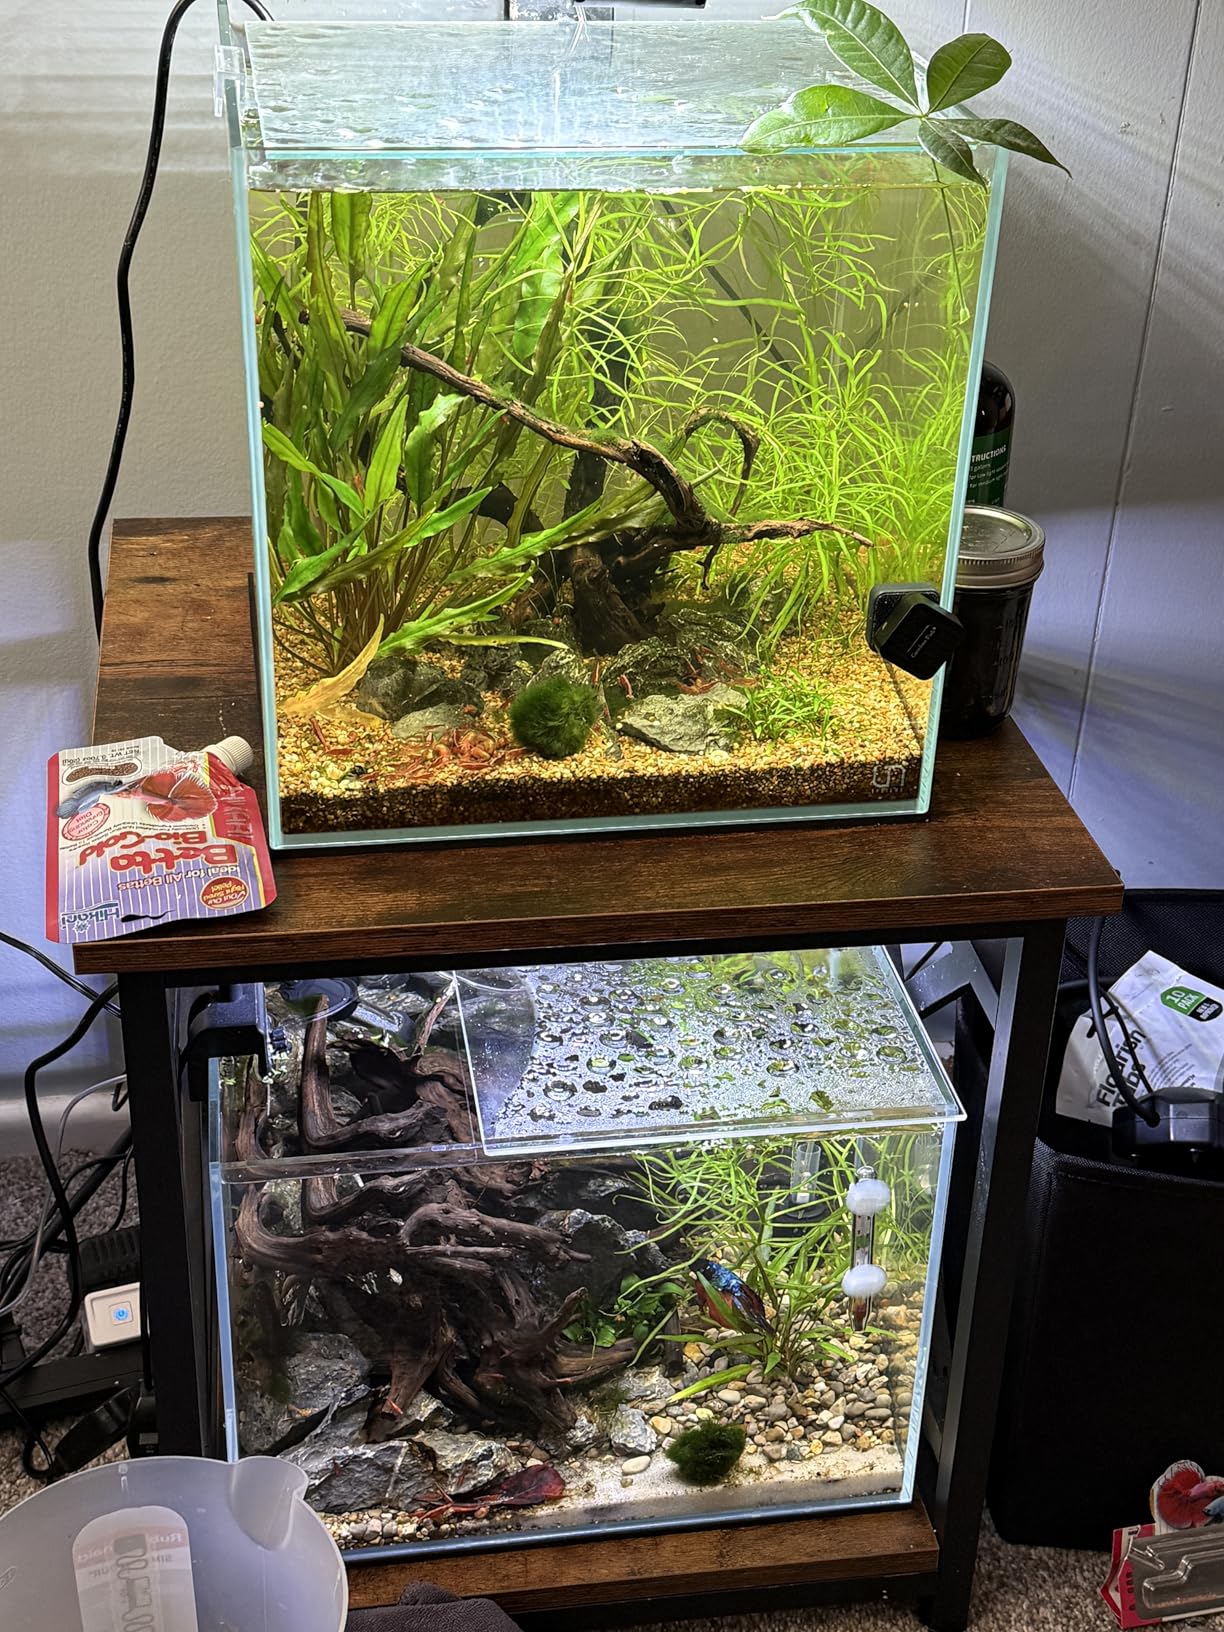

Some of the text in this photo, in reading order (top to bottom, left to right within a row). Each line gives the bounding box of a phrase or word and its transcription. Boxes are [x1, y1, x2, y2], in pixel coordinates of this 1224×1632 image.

[78, 831, 207, 865] Bio-Gold
[110, 844, 238, 875] Betta
[117, 865, 240, 891] Ideal for All Bettas
[61, 906, 119, 929] Hikari
[1166, 990, 1186, 1003] 10
[1178, 993, 1200, 1010] PACK
